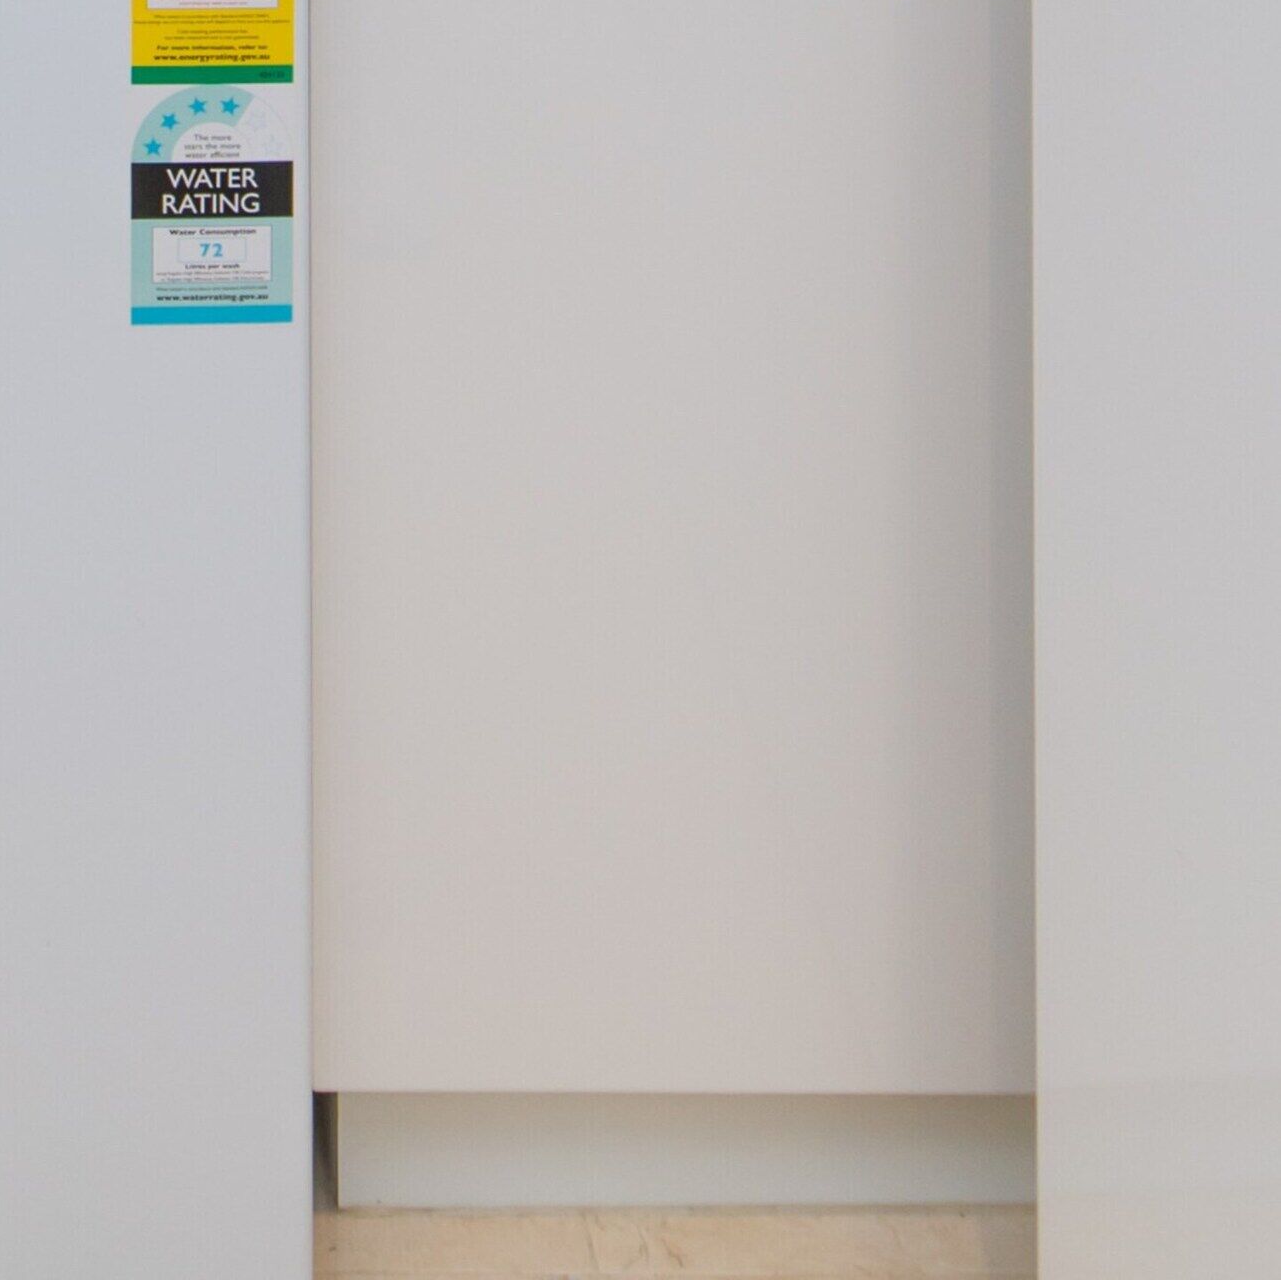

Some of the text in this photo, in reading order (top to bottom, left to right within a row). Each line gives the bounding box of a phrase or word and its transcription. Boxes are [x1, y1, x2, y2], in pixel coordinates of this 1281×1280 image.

[194, 133, 209, 141] The
[166, 168, 259, 189] WATER
[162, 193, 261, 214] RATING
[199, 228, 257, 236] Consumption
[199, 242, 224, 258] 72
